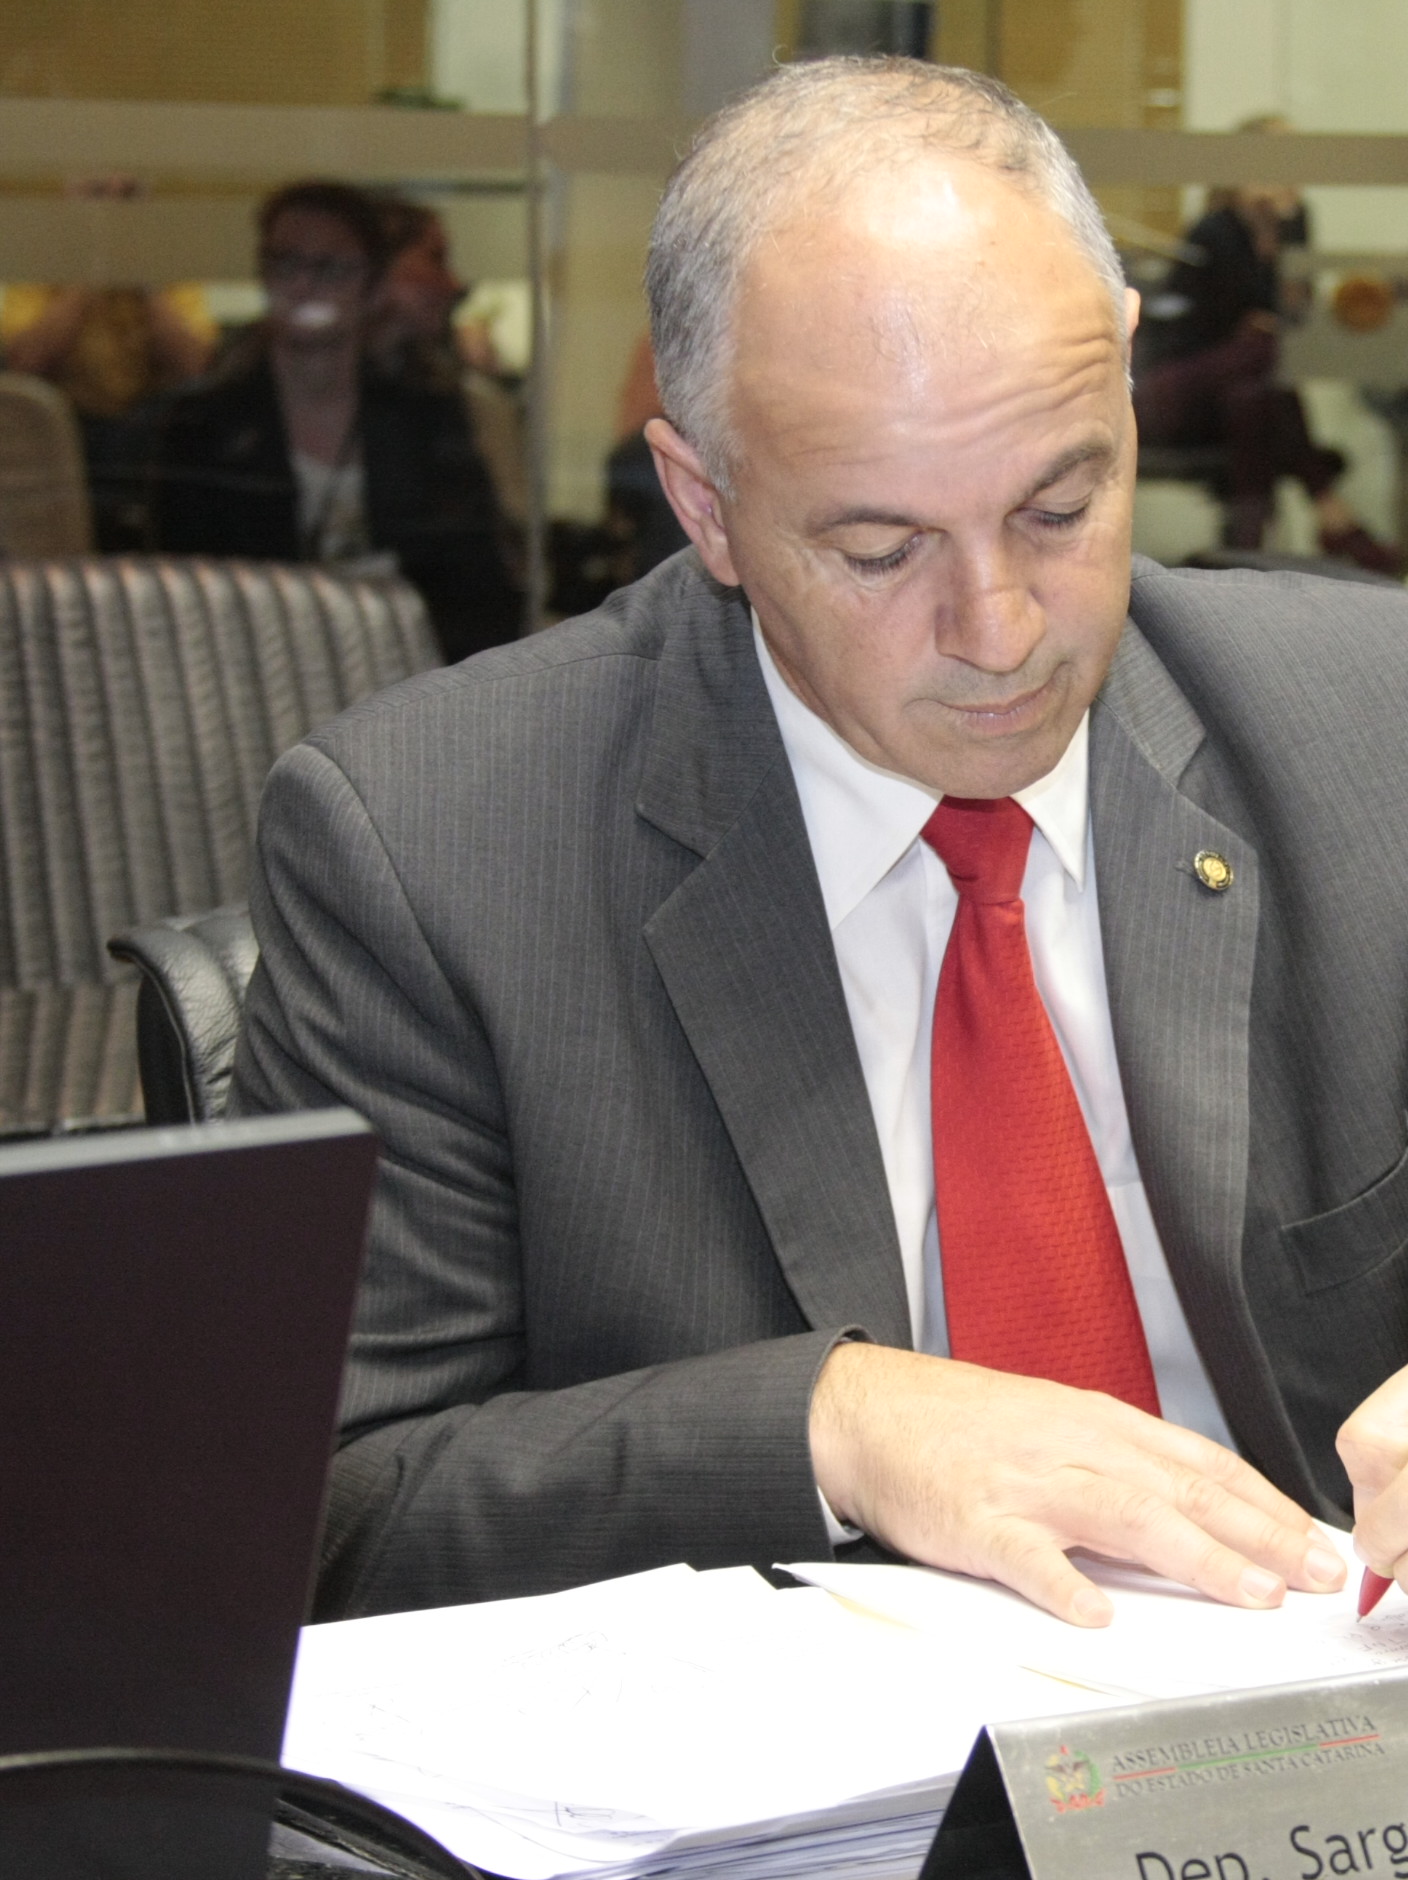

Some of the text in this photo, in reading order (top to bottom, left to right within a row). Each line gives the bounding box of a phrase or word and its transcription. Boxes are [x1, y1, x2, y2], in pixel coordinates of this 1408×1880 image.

[1113, 1715, 1377, 1771] ASSEMBLEIA LEGISLATIVA
[1116, 1742, 1386, 1798] DO ESTADO DE SANTA CATARINA
